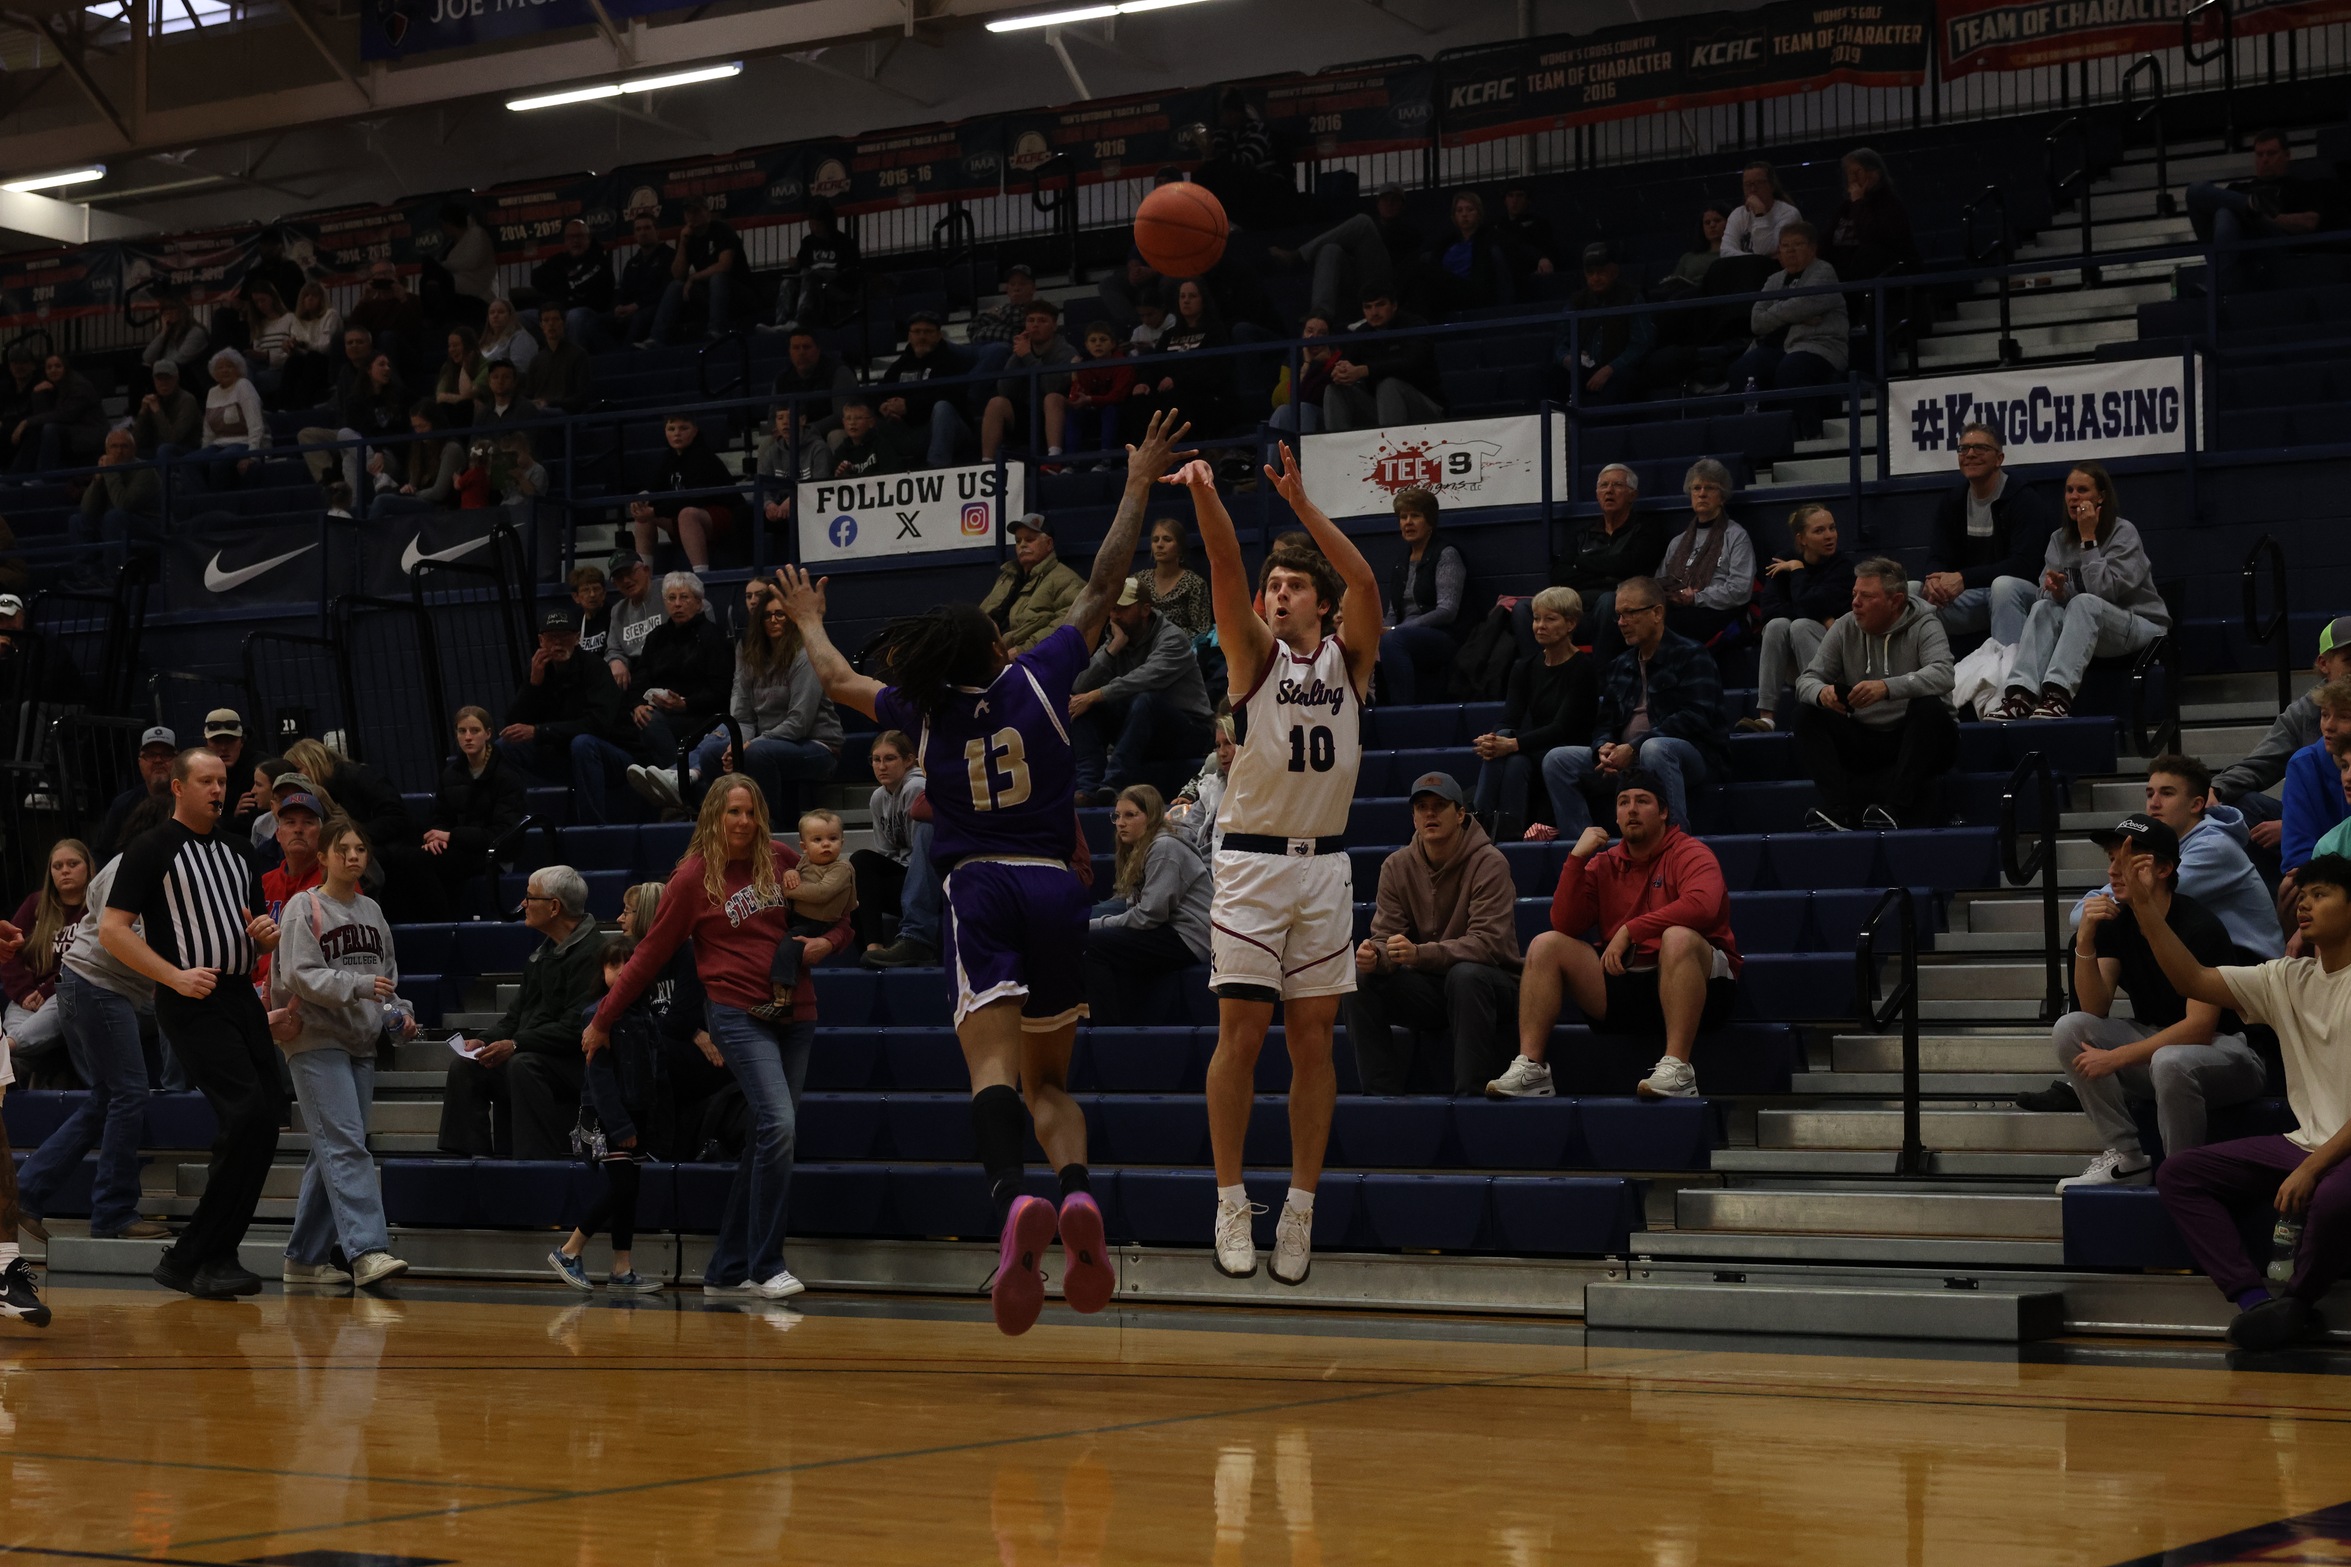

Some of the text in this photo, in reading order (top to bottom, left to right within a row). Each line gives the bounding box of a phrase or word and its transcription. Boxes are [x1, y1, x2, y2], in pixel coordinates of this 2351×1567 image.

[1859, 6, 1883, 20] GOLF
[1772, 24, 1923, 55] TEAM OF CHARACTER
[1954, 12, 2017, 53] TEAM
[2022, 8, 2050, 36] OF
[1584, 43, 1613, 60] CROSS
[1615, 35, 1656, 54] COUNTRY
[1691, 37, 1763, 68] KCAC
[1527, 51, 1672, 93] TEAM OF CHARACTER
[1450, 77, 1516, 109] KCAC
[1583, 82, 1617, 102] 2016
[1309, 114, 1342, 134] 2016
[1398, 106, 1428, 120] IMA
[1094, 138, 1126, 158] 2016
[970, 158, 996, 171] IMA
[878, 168, 908, 188] 2015
[917, 165, 932, 182] 16
[706, 193, 728, 211] 015
[771, 186, 798, 198] IMA
[500, 224, 527, 241] 2014
[534, 219, 562, 238] 2015
[586, 213, 612, 226] IMA
[1382, 452, 1472, 482] TEE 9
[816, 469, 1009, 513] FOLLOW US!
[625, 616, 660, 640] STERNG
[1287, 725, 1335, 772] 10
[963, 726, 1032, 812] 13
[342, 955, 377, 965] COLLEGE
